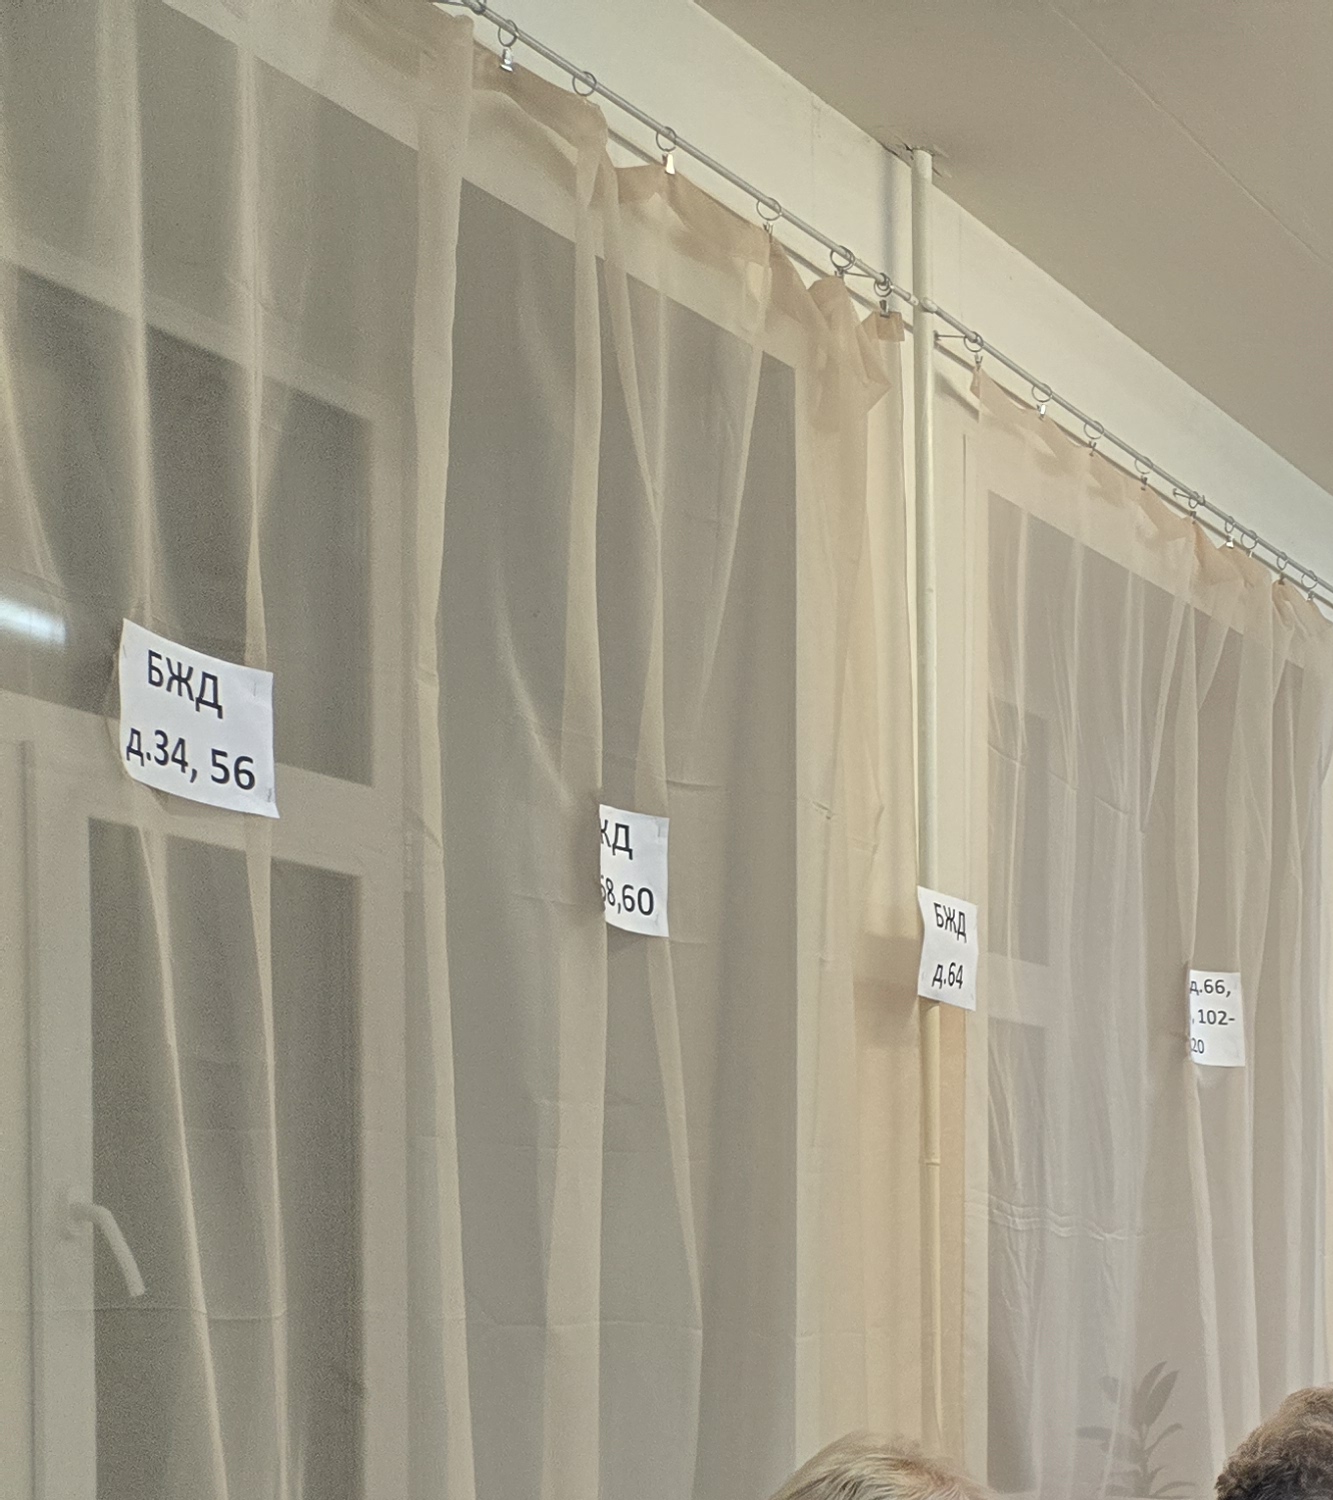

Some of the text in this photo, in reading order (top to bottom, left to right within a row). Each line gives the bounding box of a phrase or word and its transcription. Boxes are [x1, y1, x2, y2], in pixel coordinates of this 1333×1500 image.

[148, 649, 223, 719] БЖД
[126, 728, 256, 790] д.34, 56
[933, 902, 967, 943] БЖД
[931, 962, 963, 989] д.64
